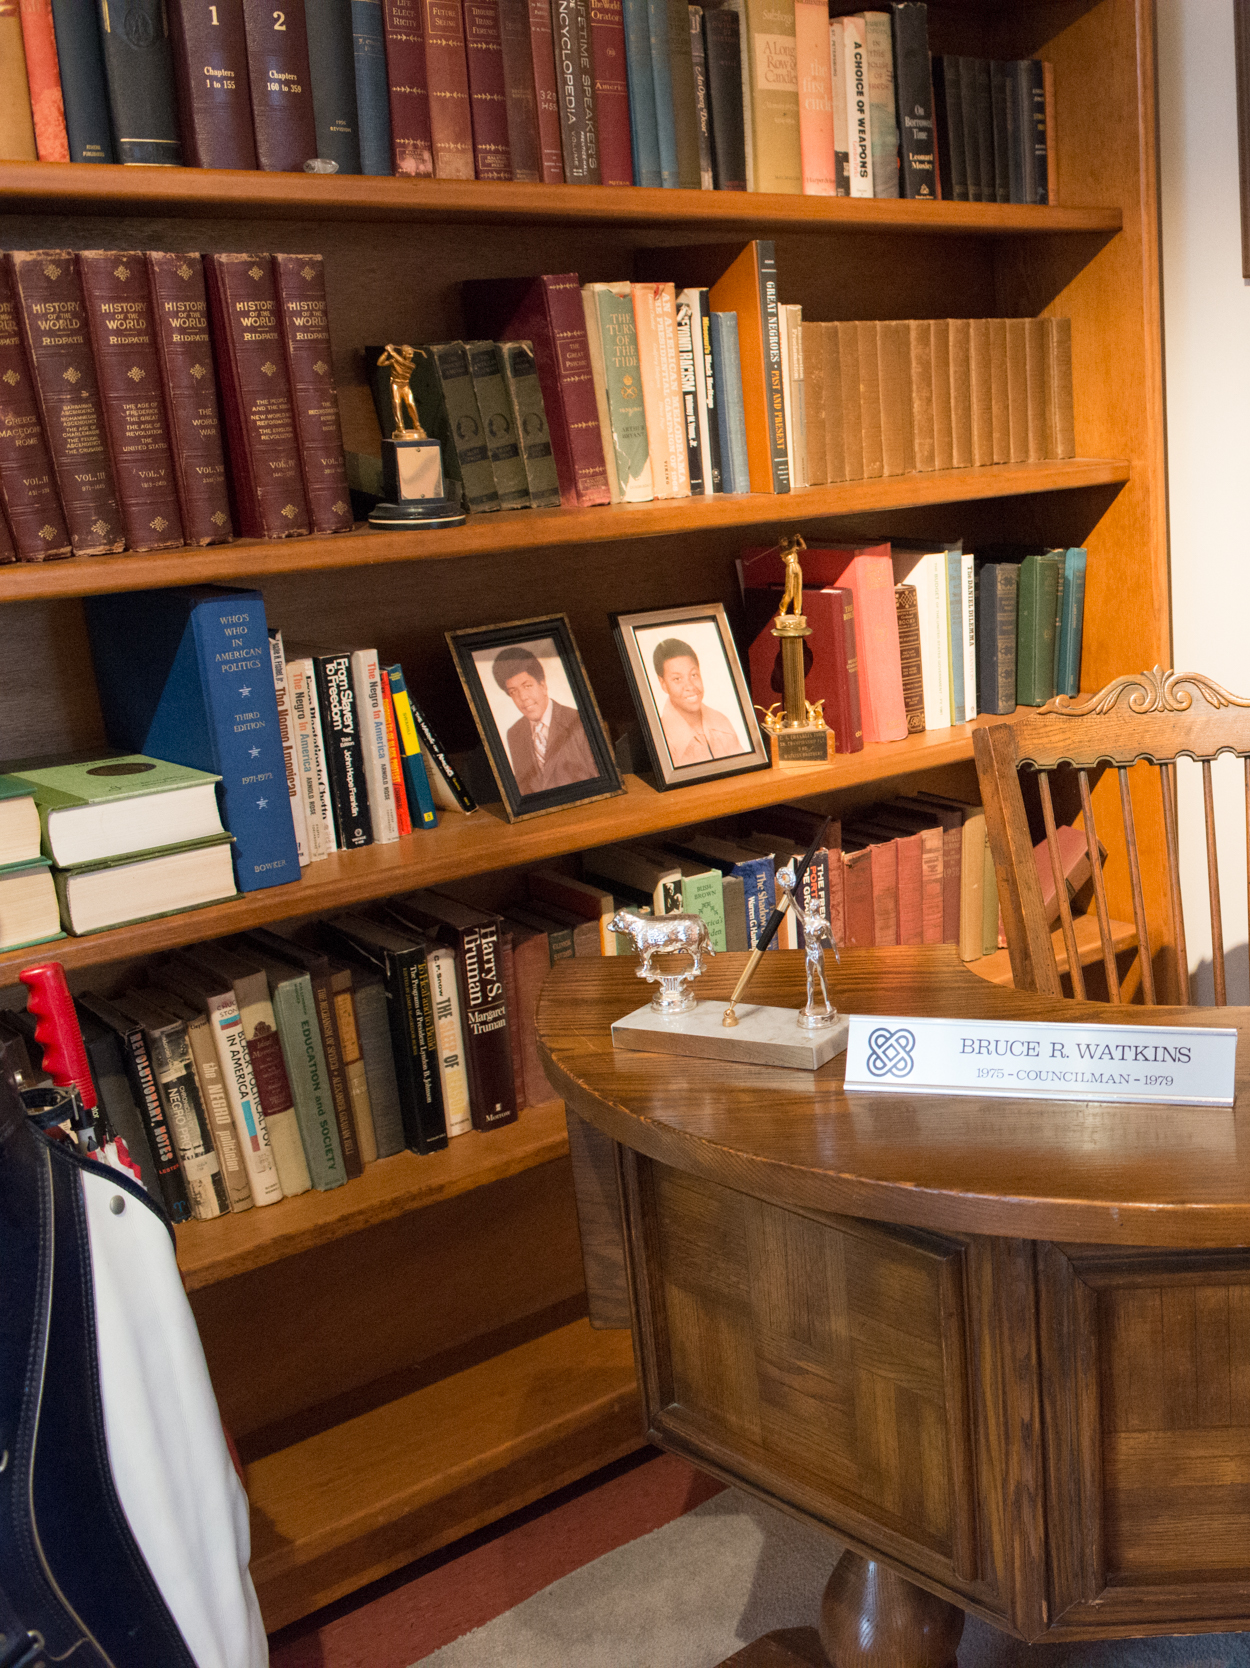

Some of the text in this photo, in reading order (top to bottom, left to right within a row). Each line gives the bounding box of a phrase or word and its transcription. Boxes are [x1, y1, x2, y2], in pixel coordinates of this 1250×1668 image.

[209, 6, 220, 25] 1
[273, 11, 286, 31] 2
[393, 17, 417, 28] RICITY
[764, 41, 795, 57] A Long
[767, 57, 787, 69] Row
[811, 59, 827, 76] the
[204, 66, 235, 78] Chapters
[269, 70, 298, 81] Chapters
[206, 79, 236, 89] 1 to 155
[267, 82, 302, 93] 160 to 359
[803, 77, 825, 92] first
[854, 42, 868, 178] A CHOICE OF WEAPONS
[914, 104, 924, 116] On
[912, 128, 928, 140] Time
[909, 153, 933, 161] Leonard
[911, 161, 933, 171] Mosley
[765, 281, 776, 313] GREAT
[32, 302, 80, 314] HISTORY
[101, 302, 146, 313] HISTORY
[38, 319, 80, 330] WORLD
[106, 319, 146, 329] WORLD
[169, 318, 207, 328] WORLD
[241, 317, 276, 326] WORLD
[293, 317, 327, 326] WORLD
[610, 313, 632, 324] THE
[606, 324, 635, 335] TURN
[42, 335, 84, 345] RIDPATH
[109, 336, 149, 344] RIDPATH
[616, 335, 630, 345] OF
[768, 316, 780, 363] NEGROES
[614, 346, 636, 356] THE
[612, 357, 638, 367] TIDE
[771, 370, 781, 390] PAST
[663, 293, 685, 484] AN AMERICAN MELODRAMA
[772, 392, 782, 410] AND
[198, 408, 212, 416] THE
[5, 416, 37, 426] GREECE
[192, 418, 218, 426] WORLD
[126, 429, 163, 437] REVOLUTION
[773, 412, 785, 450] PRESENT
[16, 437, 38, 447] ROME
[967, 579, 975, 608] DANIEL
[220, 614, 250, 626] WHO'S
[224, 626, 248, 637] WHO
[968, 609, 976, 646] DILEMMA
[232, 638, 243, 648] IN
[215, 648, 262, 663] AMERICAN
[221, 660, 261, 673] POLITICS
[367, 662, 376, 679] The
[325, 663, 342, 730] To Freedom
[334, 658, 355, 734] From Slavery
[368, 681, 379, 708] Negro
[294, 692, 304, 720] Negro
[234, 711, 260, 722] THIRD
[372, 709, 381, 719] In
[234, 721, 266, 733] EDITION
[298, 721, 308, 731] In
[403, 712, 411, 735] SWAHILI
[374, 721, 385, 759] America
[299, 733, 312, 773] America
[242, 772, 273, 785] 1971-1972
[344, 750, 359, 816] John Hope Franklin
[306, 777, 314, 799] ARNOLD
[254, 858, 287, 872] BOWKER
[694, 890, 717, 899] BROWN
[696, 884, 713, 892] BUSH-
[756, 872, 768, 927] The Shadow
[464, 928, 483, 1006] Truman
[480, 926, 503, 1001] Harry S.
[436, 997, 453, 1020] THE
[468, 1006, 506, 1024] Margaret
[470, 1019, 506, 1035] Truman
[439, 1020, 457, 1052] SLEEP
[959, 1037, 1192, 1065] BRUCE R. WATKINS
[226, 1035, 249, 1100] IN AMERICA
[443, 1054, 460, 1068] OF
[976, 1067, 1174, 1087] 1975 COUNCILMAN 1979
[301, 1020, 337, 1170] EDUCATION and SOCIETY
[167, 1088, 187, 1125] NEGRO
[202, 1062, 239, 1172] the NEGRO politician
[486, 1110, 511, 1122] Morrow
